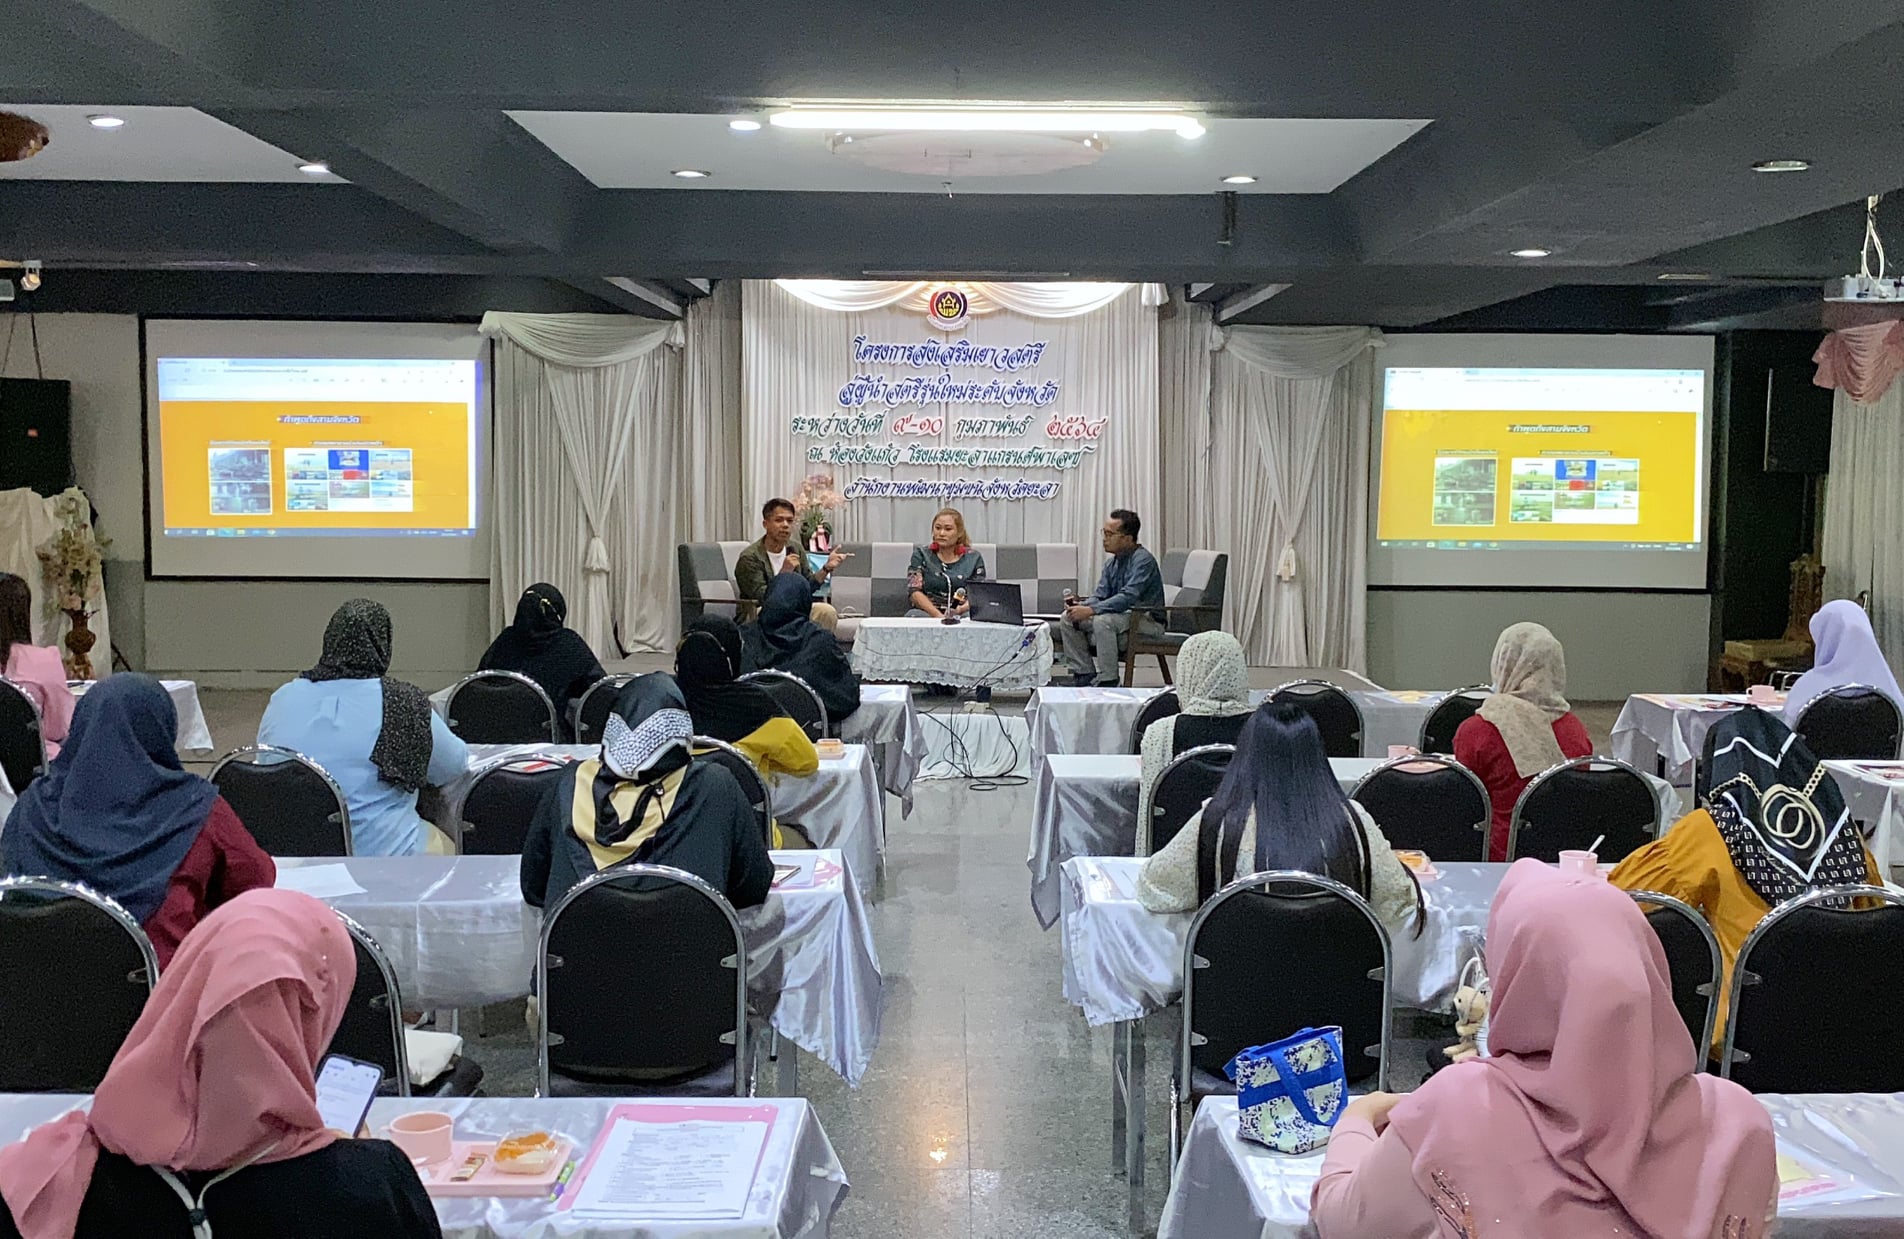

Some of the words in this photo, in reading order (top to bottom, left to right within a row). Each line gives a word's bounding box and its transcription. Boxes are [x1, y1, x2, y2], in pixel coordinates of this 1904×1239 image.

[854, 336, 1045, 368] โครงการส่งเสริมเยาวสตรี
[792, 411, 887, 437] ระหว่างวันที่
[893, 414, 943, 435] ๙-๑๐
[955, 414, 1033, 438] กุมภาพันธ์
[808, 446, 823, 460] ณ
[830, 442, 901, 464] ห้องวังแก้ว
